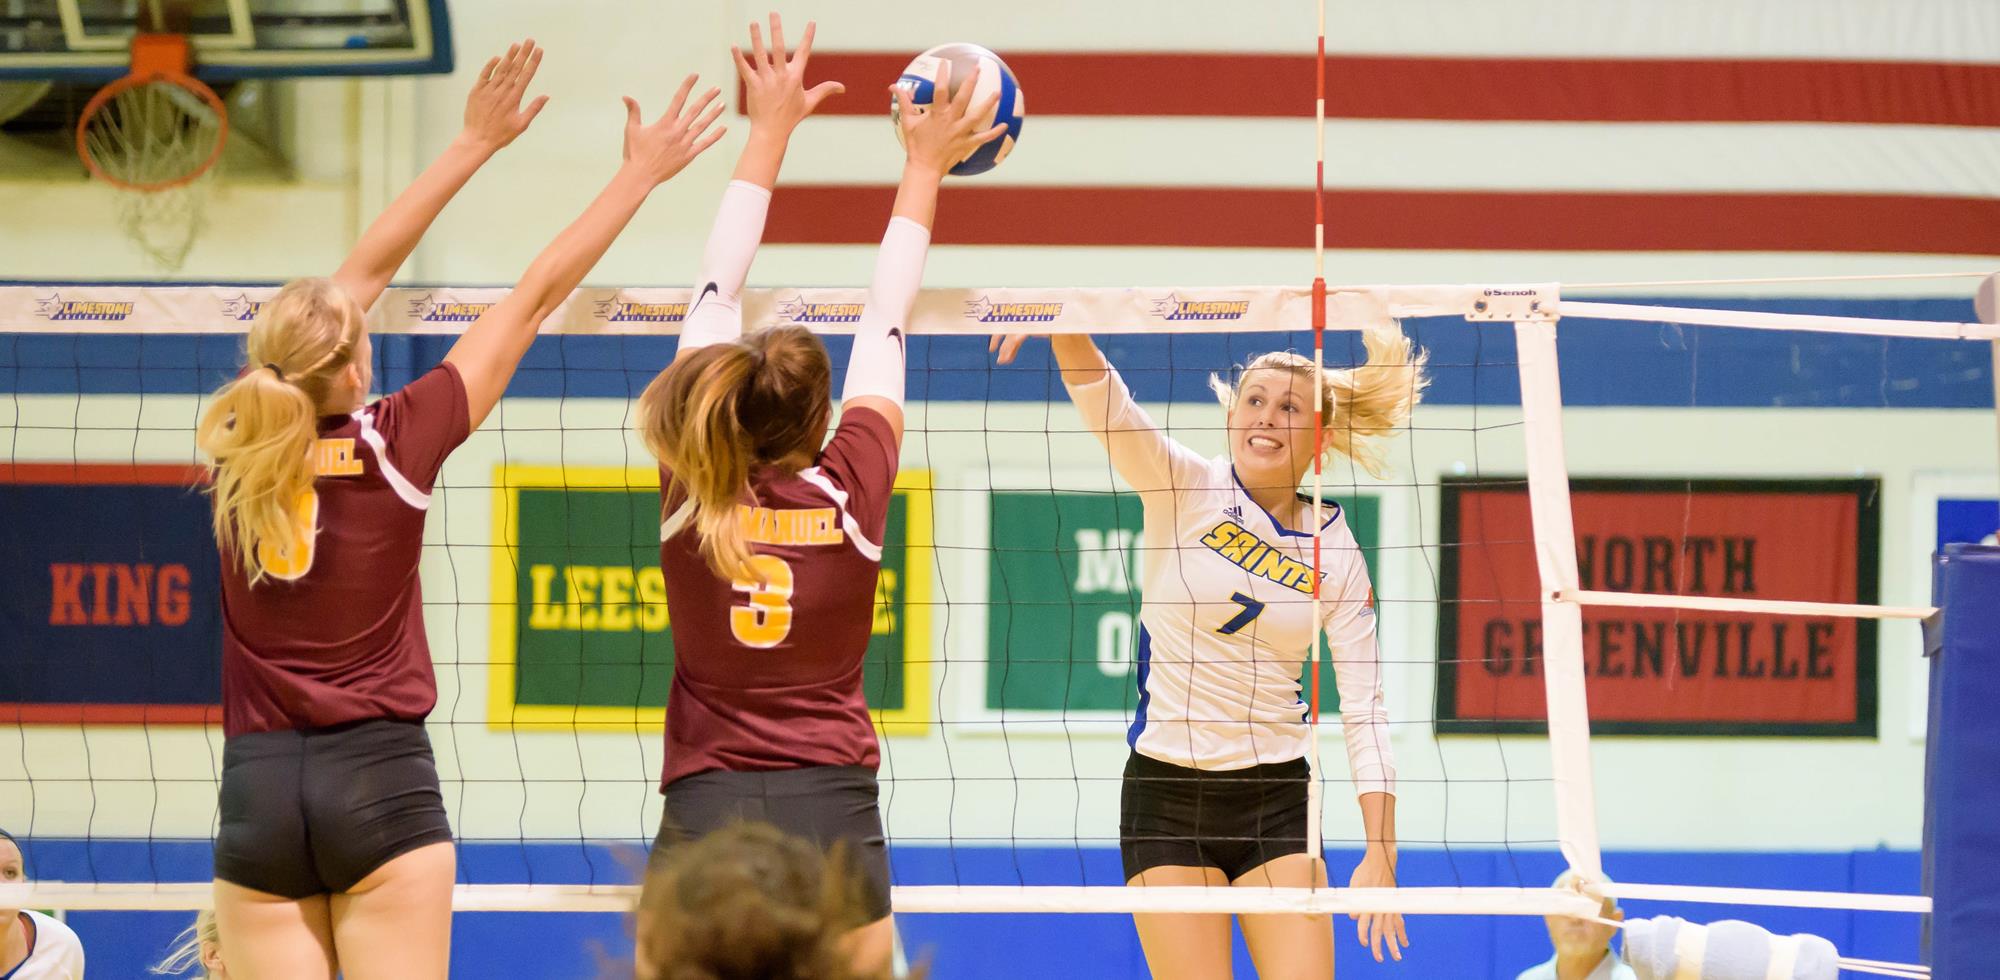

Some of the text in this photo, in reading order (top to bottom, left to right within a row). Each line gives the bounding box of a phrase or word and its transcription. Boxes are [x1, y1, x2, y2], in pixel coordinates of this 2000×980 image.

[62, 302, 134, 315] LIMESTONE
[805, 304, 865, 316] LIMESTO
[992, 304, 1063, 316] LIMESTONE
[1178, 301, 1249, 314] LIMESTONE
[736, 506, 844, 545] MANUEL
[1200, 521, 1328, 594] SAINTS
[49, 563, 192, 626] KING
[730, 554, 793, 648] 3
[1216, 591, 1265, 634] 7
[1484, 618, 1835, 679] GRENVILLE
